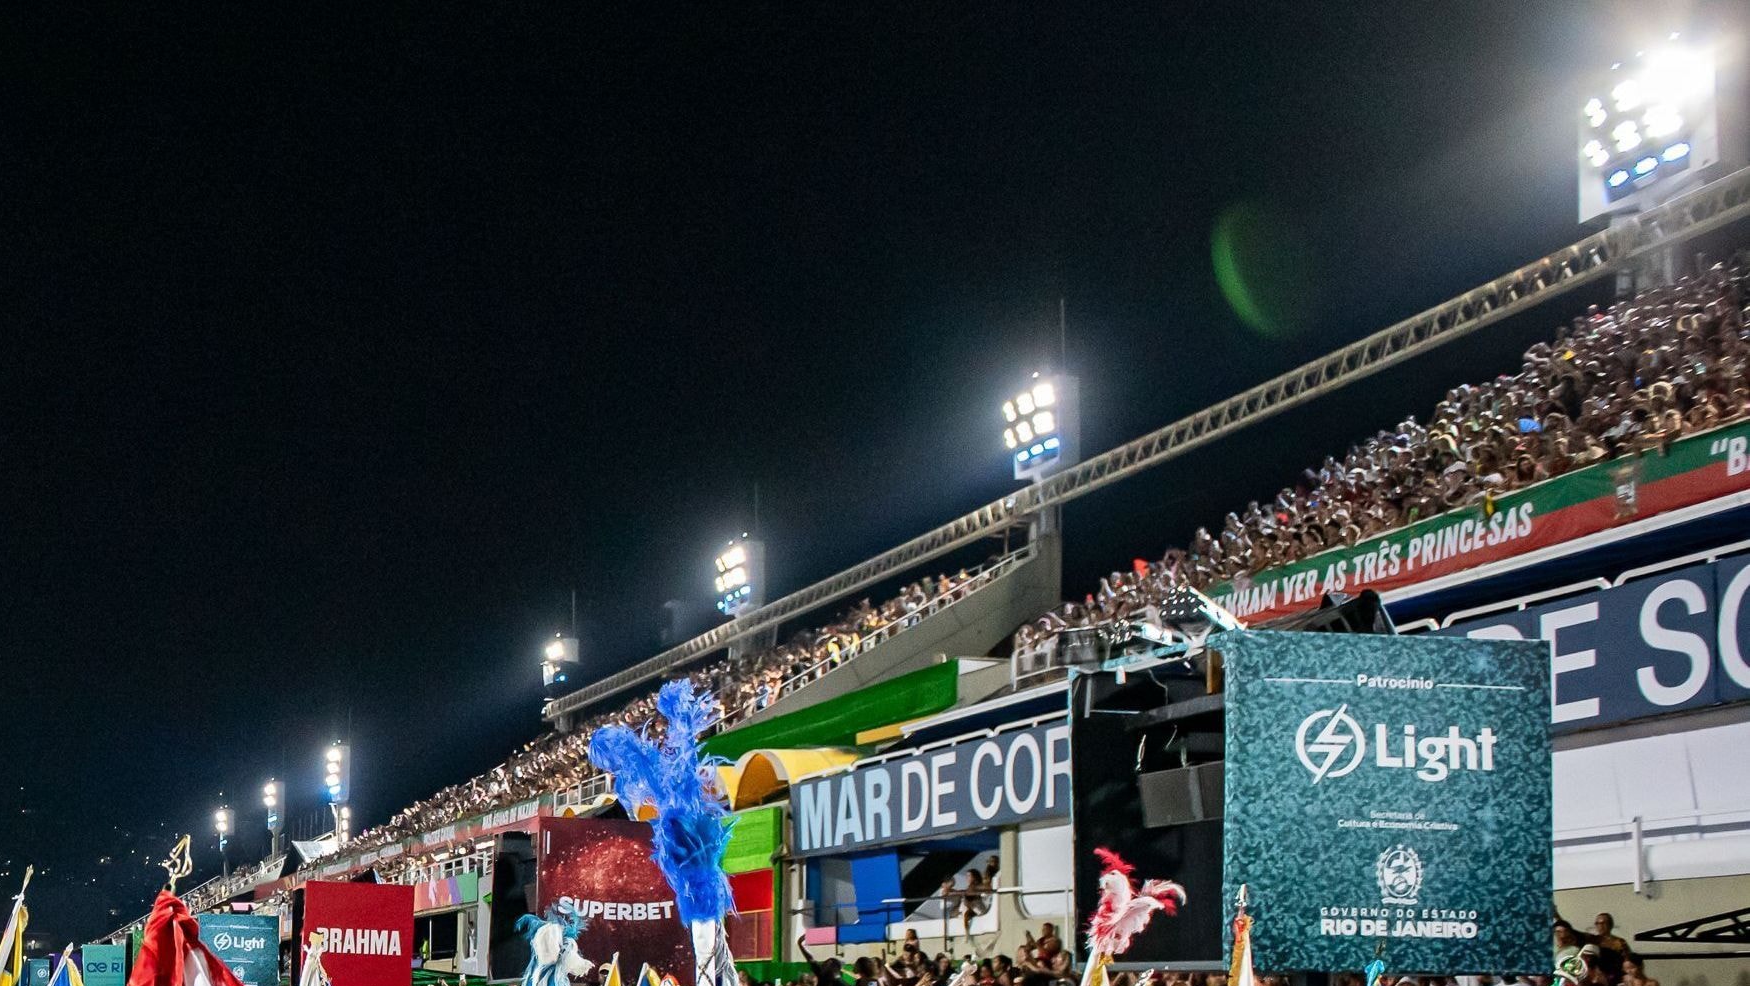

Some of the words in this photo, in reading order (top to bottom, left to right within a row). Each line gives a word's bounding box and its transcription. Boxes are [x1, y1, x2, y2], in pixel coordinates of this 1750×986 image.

[1283, 569, 1317, 606] VER
[1321, 560, 1347, 595] AS
[1353, 540, 1401, 586] TRÊS
[1406, 501, 1534, 572] PRINCESAS
[1356, 674, 1434, 691] Patrocínio
[1375, 723, 1497, 783] Light
[800, 768, 892, 850] MAR
[901, 751, 957, 834] DE
[557, 896, 674, 922] SUPERBET
[1320, 906, 1390, 918] GOVERNO
[1396, 908, 1415, 918] DO
[1422, 908, 1478, 920] ESTADO
[1320, 919, 1357, 936] RIO
[1360, 919, 1388, 936] DE
[1392, 921, 1478, 939] JANEIRO
[233, 936, 265, 951] Light
[317, 927, 401, 956] BRAHMA
[111, 962, 124, 973] RI
